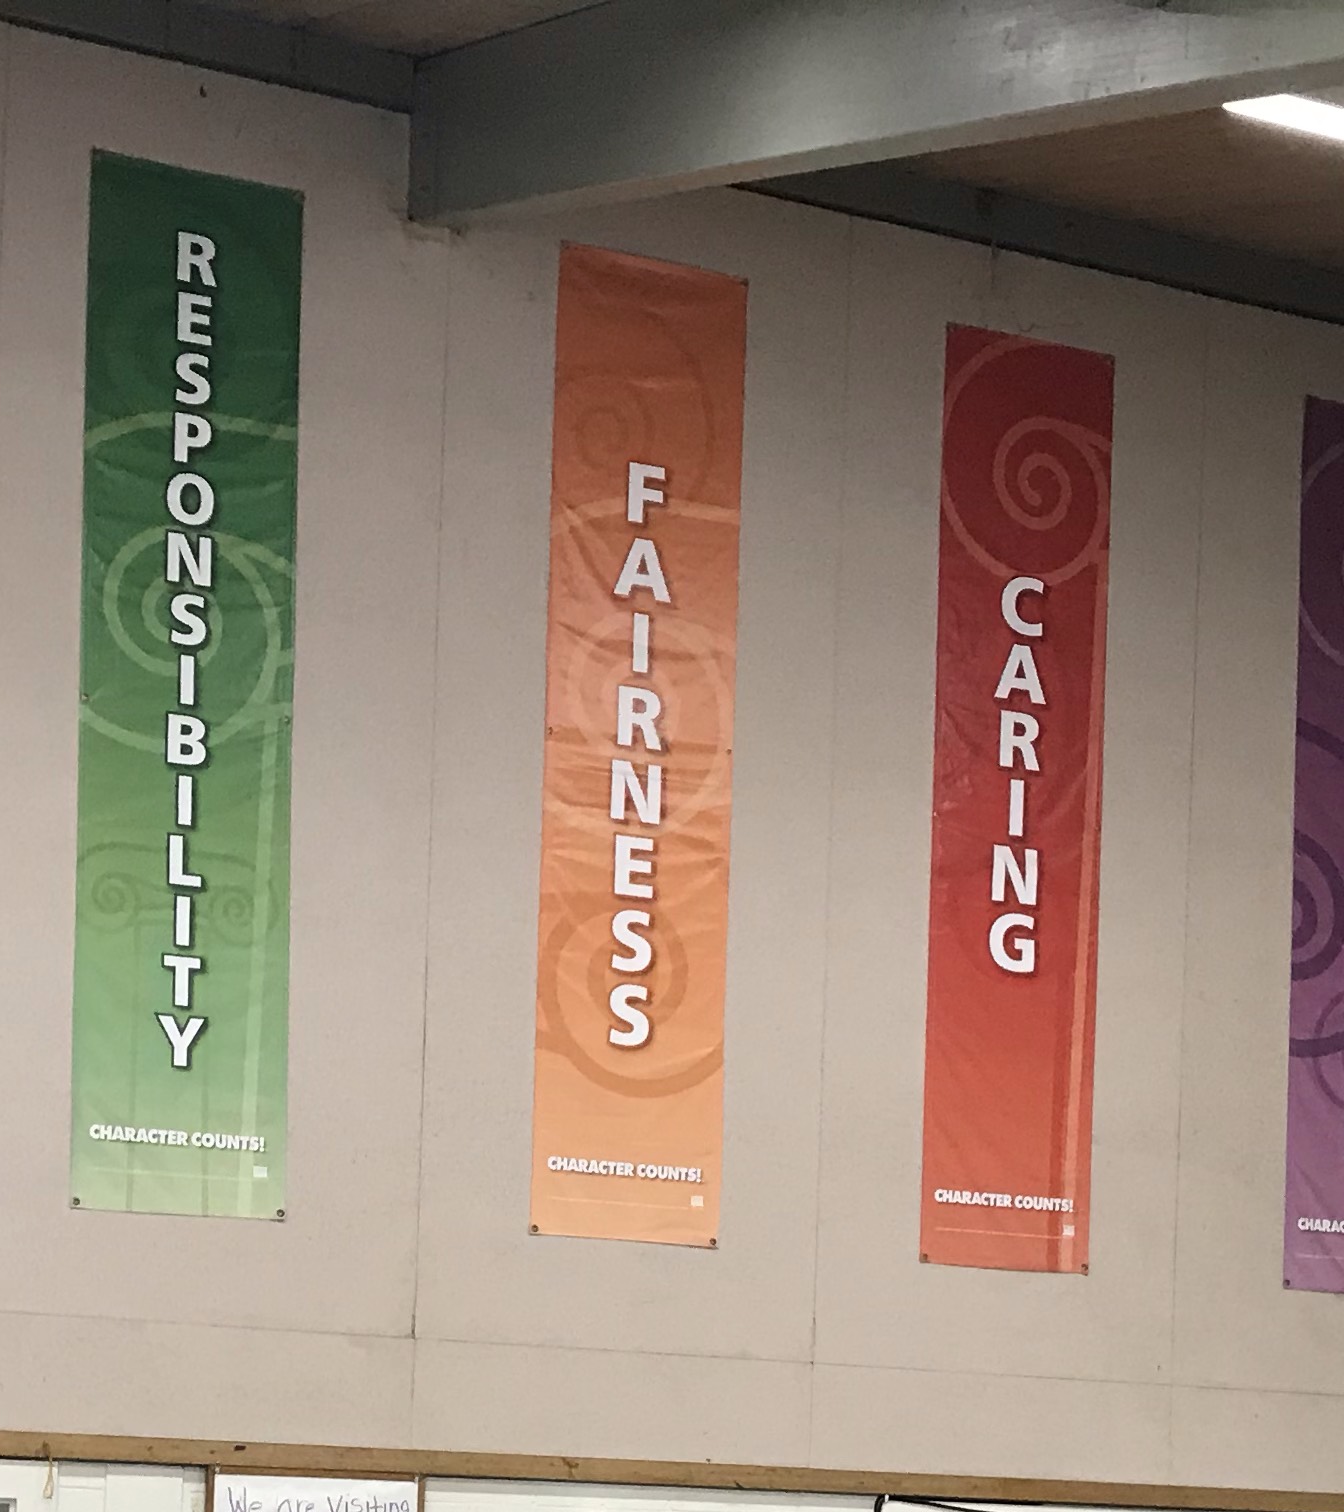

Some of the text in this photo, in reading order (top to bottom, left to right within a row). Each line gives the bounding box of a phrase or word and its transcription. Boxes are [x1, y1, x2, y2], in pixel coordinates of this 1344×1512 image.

[155, 229, 218, 1070] RESPONSIBILITY
[608, 461, 672, 1049] FAIRNESS
[988, 575, 1045, 975] CARING
[89, 1124, 265, 1152] CHARACTER COUNTS!
[548, 1156, 702, 1183] CHARACTER COUNTS!
[934, 1189, 1074, 1212] CHARACTER COUNTS!
